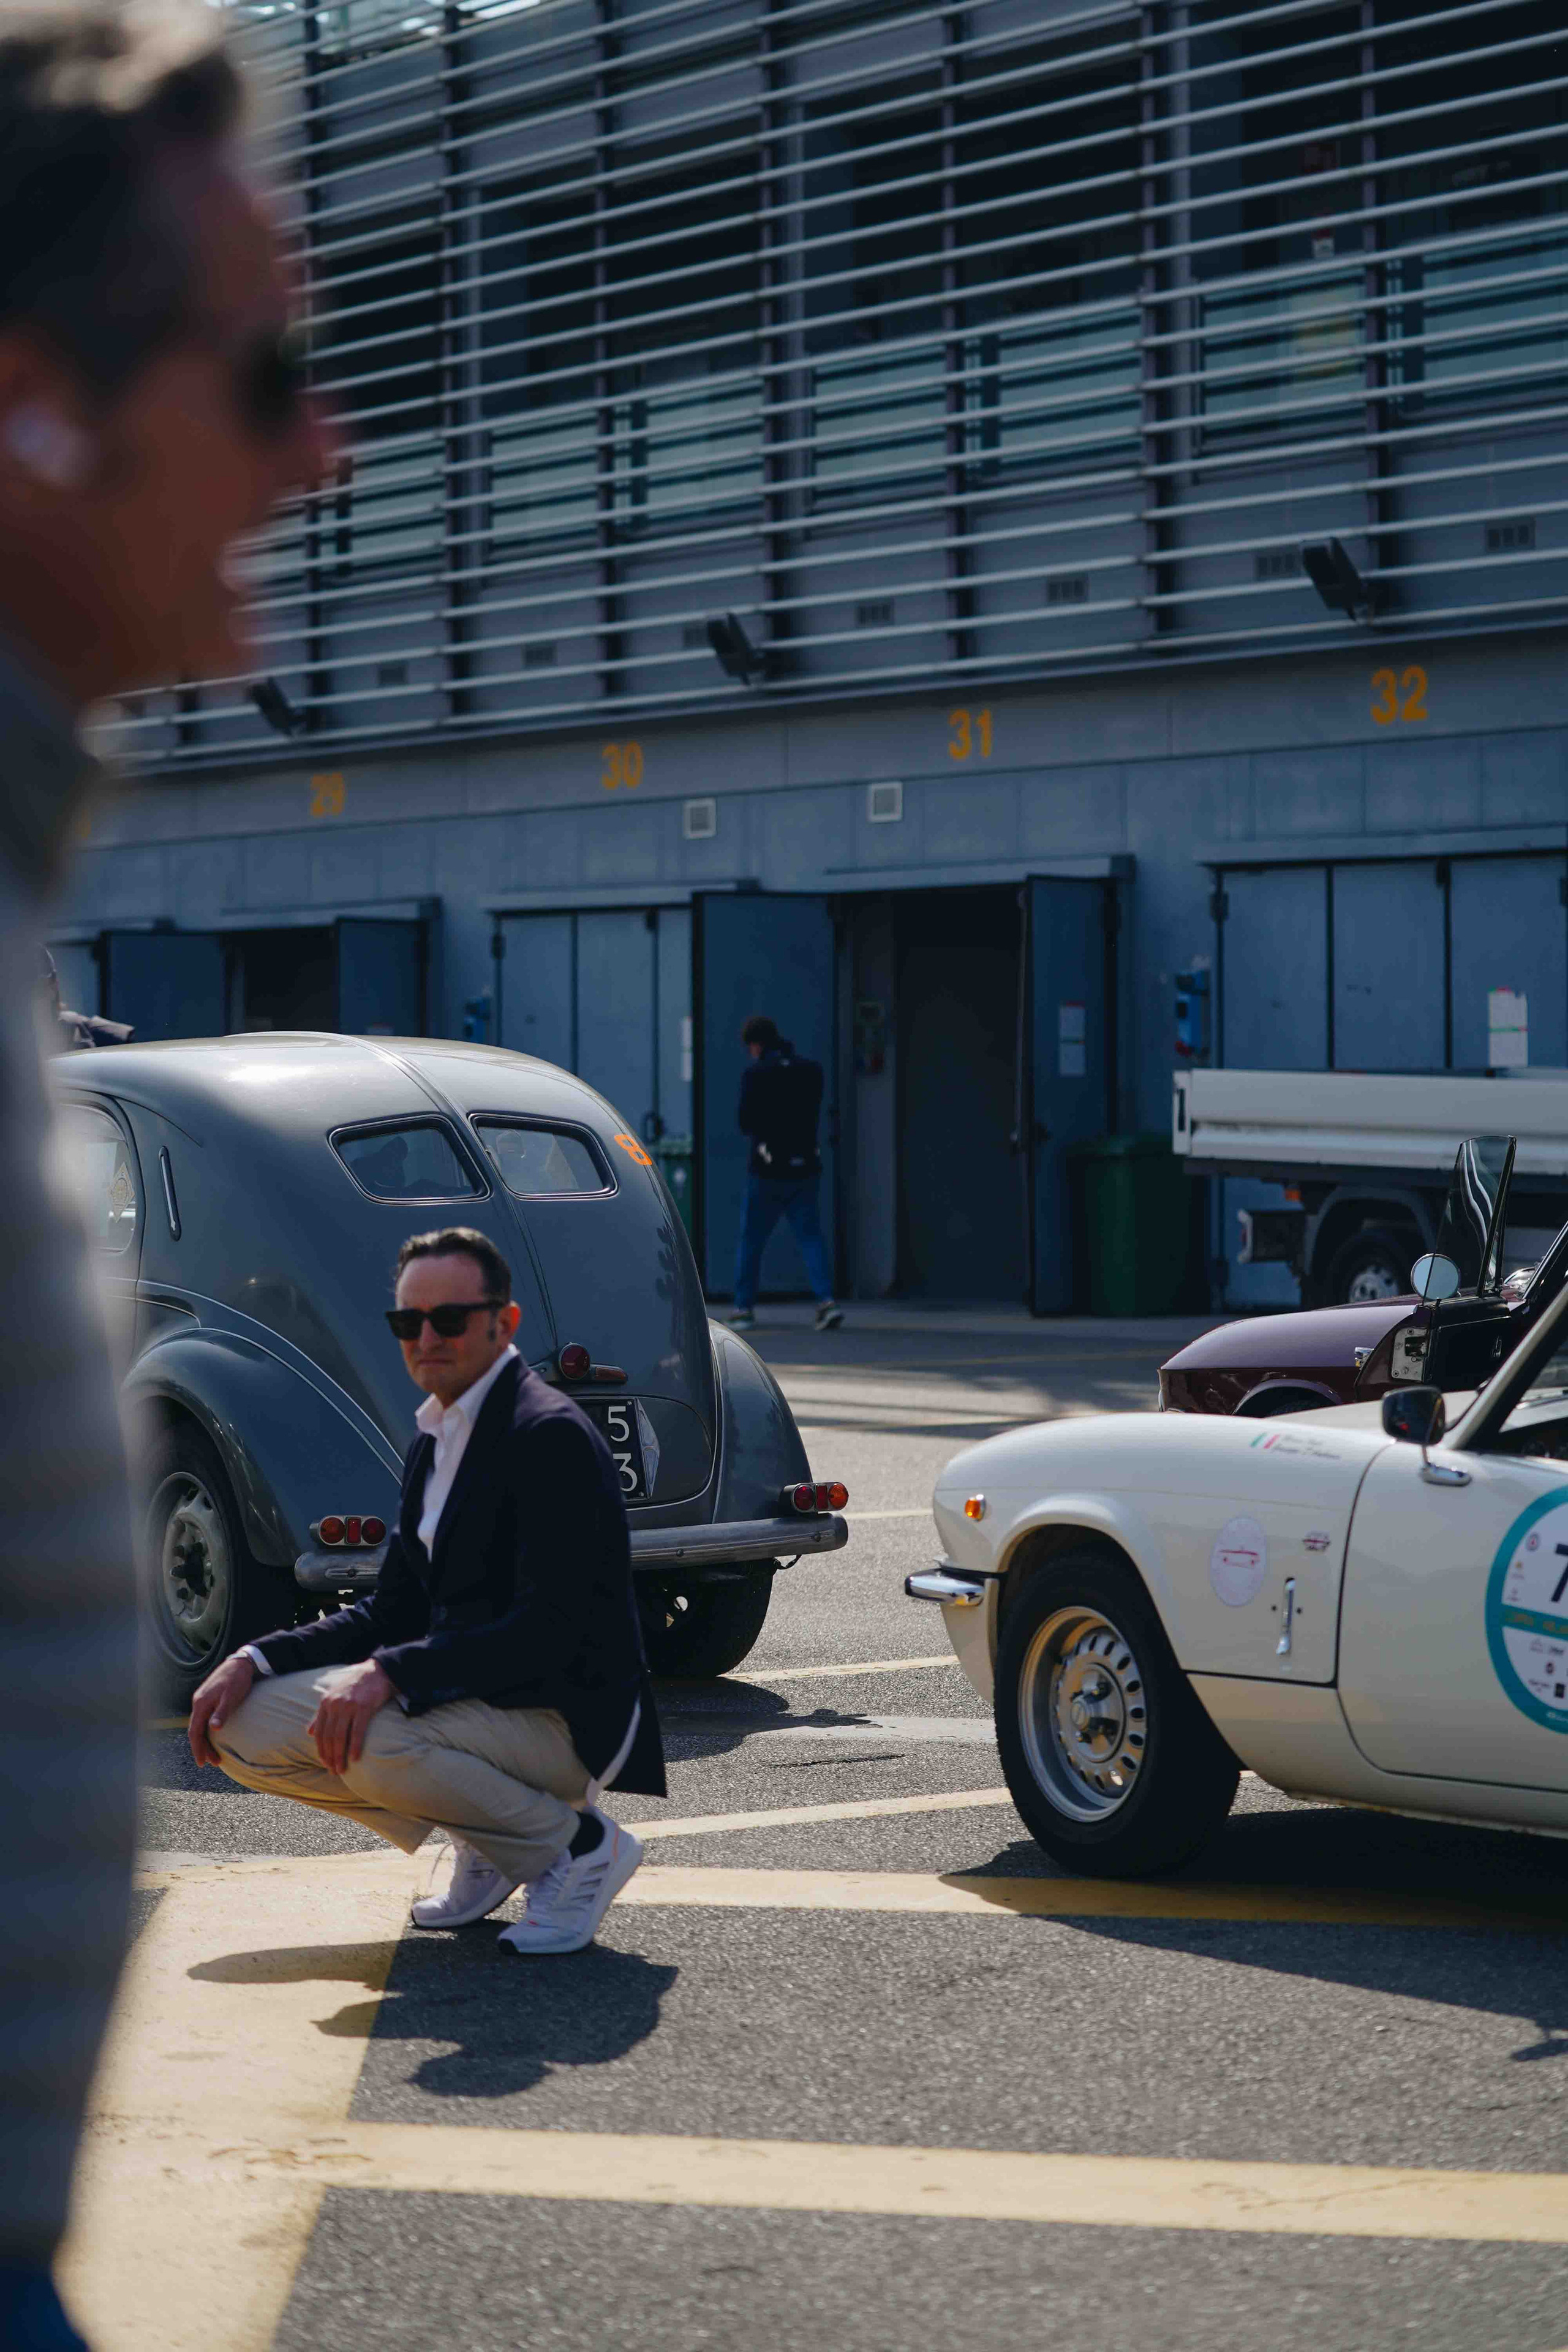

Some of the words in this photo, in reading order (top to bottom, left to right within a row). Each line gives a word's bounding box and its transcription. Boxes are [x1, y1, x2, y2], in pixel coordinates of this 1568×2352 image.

[1371, 665, 1427, 724] 32
[949, 708, 992, 759] 31
[601, 741, 643, 790] 30
[608, 1406, 630, 1442] 5
[612, 1453, 638, 1492] 3
